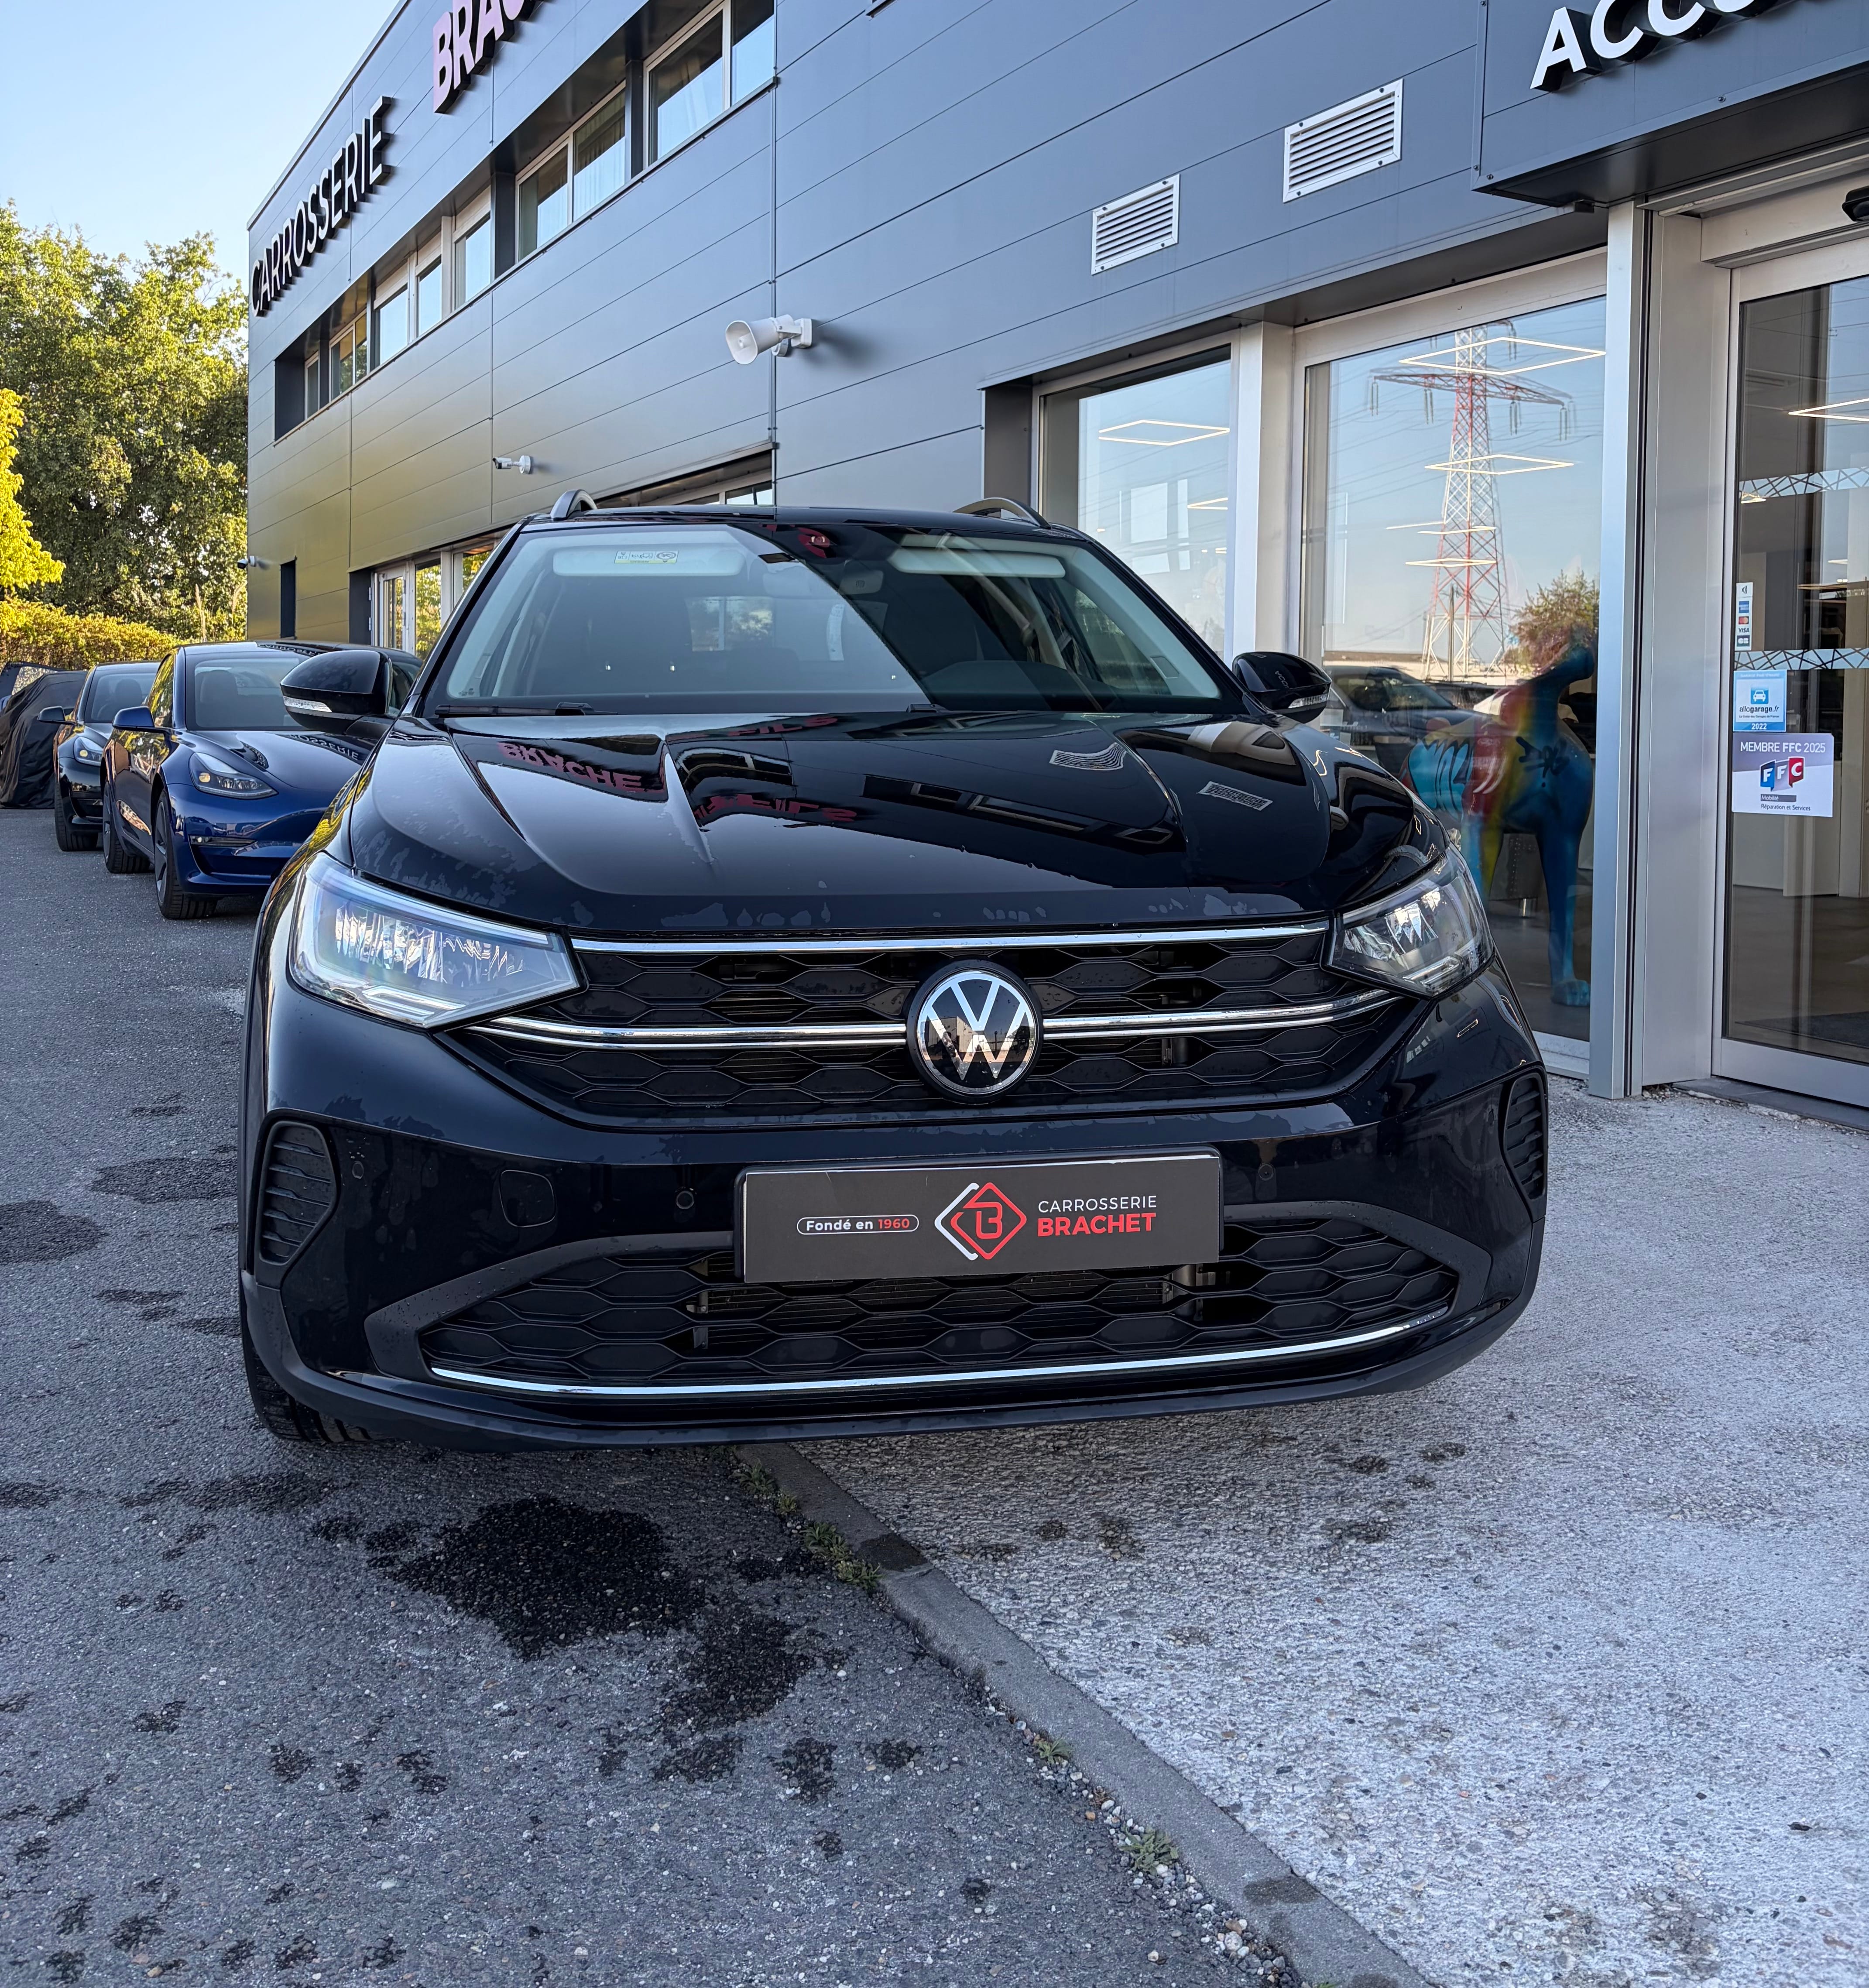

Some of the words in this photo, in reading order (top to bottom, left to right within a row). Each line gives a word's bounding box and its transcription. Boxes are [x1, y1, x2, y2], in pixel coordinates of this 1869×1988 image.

[433, 0, 525, 113] BRA
[1530, 0, 1755, 89] ACC
[252, 96, 383, 317] CARROSSERIE
[1740, 742, 1780, 752] MEMBRE
[1782, 742, 1802, 752] FFC
[1804, 743, 1825, 753] 2025
[1763, 762, 1802, 782] FFC
[919, 973, 1035, 1091] VW
[1038, 1195, 1157, 1213] CARROSSERIE
[806, 1219, 851, 1231] Fondé
[856, 1221, 873, 1230] en
[878, 1218, 910, 1229] 1960
[1037, 1213, 1156, 1237] BRACHET
